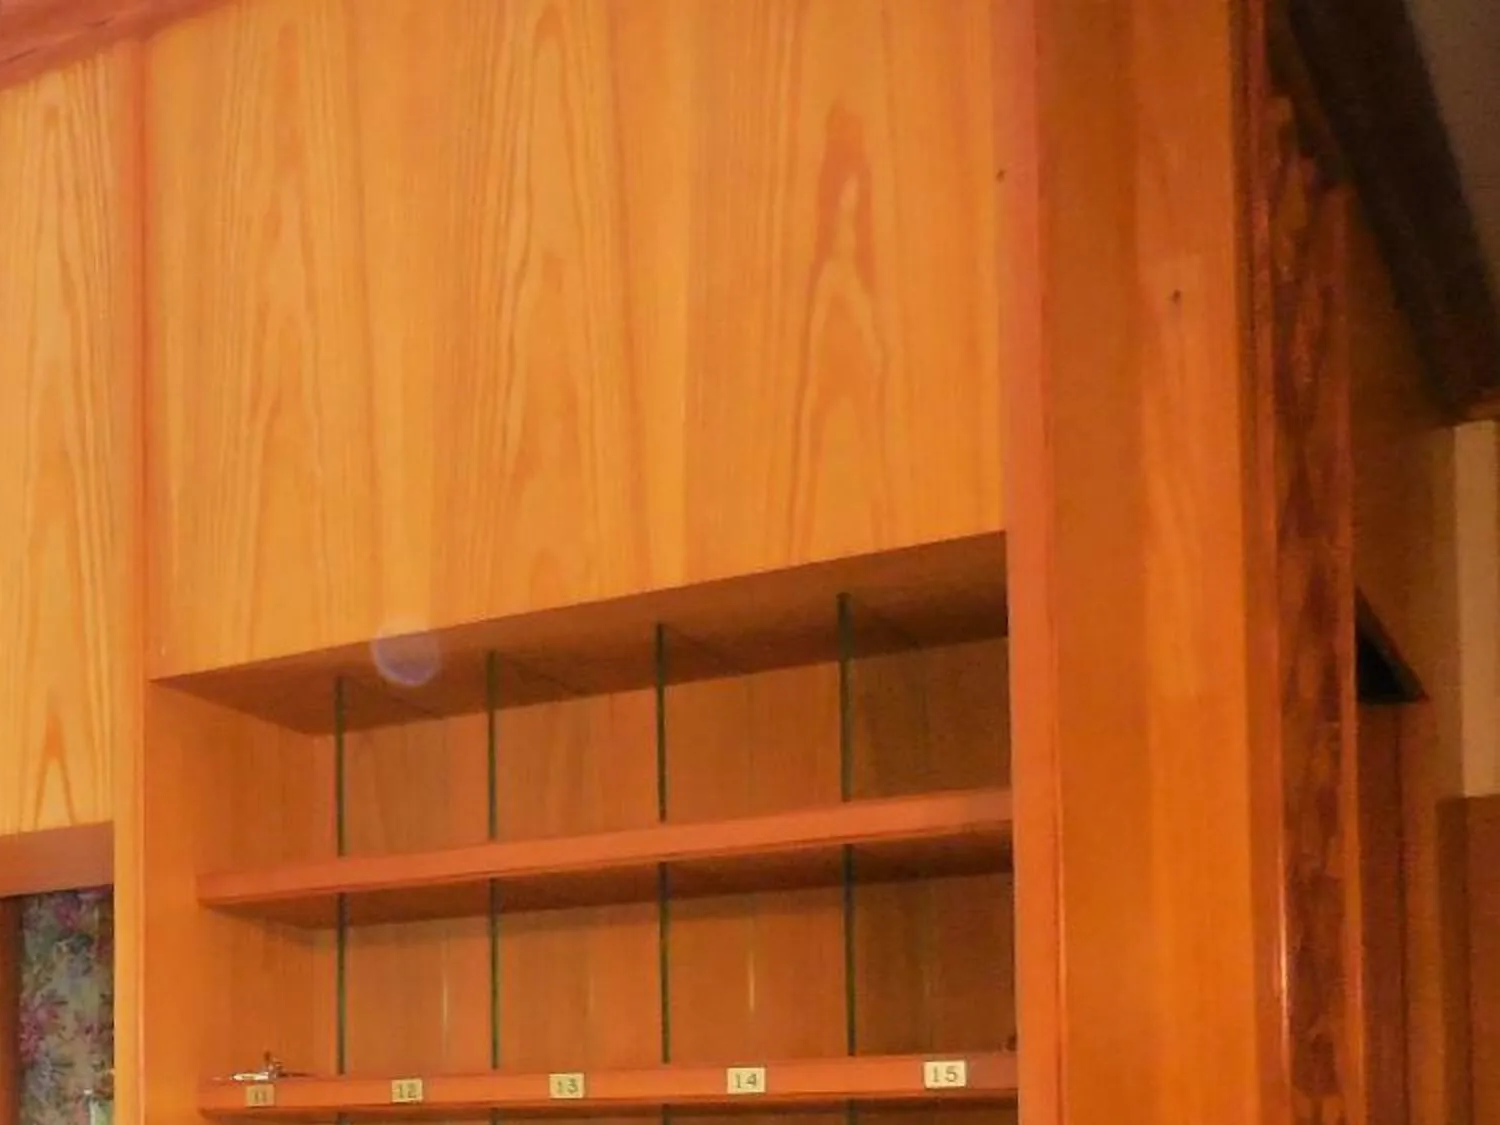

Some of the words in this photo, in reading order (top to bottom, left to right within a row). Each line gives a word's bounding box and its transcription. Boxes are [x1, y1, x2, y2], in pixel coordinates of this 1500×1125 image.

[735, 1074, 758, 1089] 14
[932, 1067, 958, 1083] 15
[398, 1084, 417, 1099] 12
[557, 1079, 578, 1094] 13
